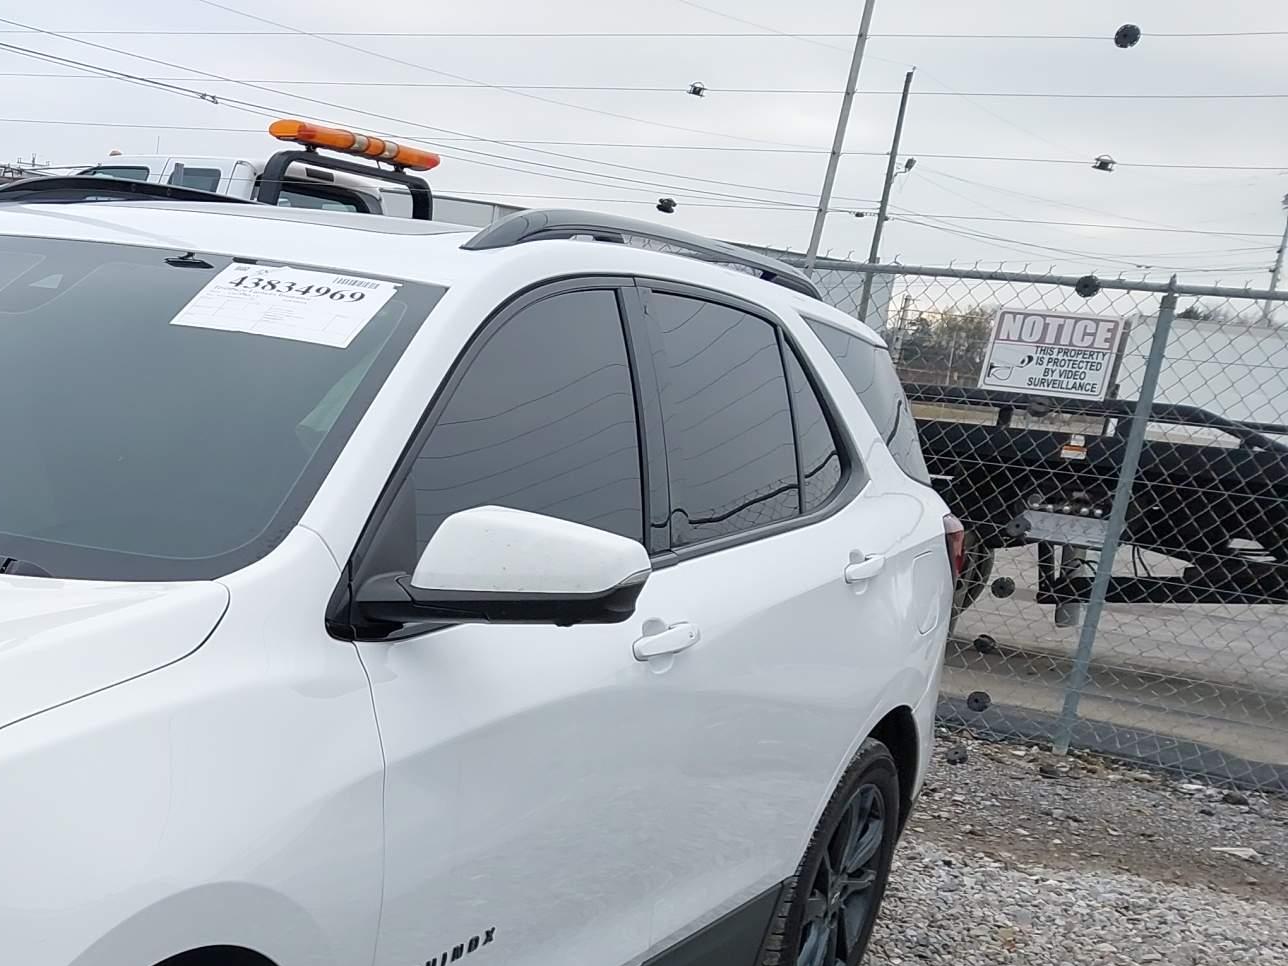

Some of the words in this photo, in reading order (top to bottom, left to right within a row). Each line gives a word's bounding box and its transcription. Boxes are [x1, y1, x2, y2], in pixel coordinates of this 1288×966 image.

[228, 275, 366, 303] 43834969
[999, 314, 1115, 348] NOTICE
[1035, 346, 1055, 356] THIS
[1056, 347, 1107, 361] PROPERTY
[1035, 356, 1045, 366] IS
[1046, 357, 1103, 371] PROTECTED
[1042, 367, 1057, 378] BY
[1058, 369, 1087, 381] VIDEO
[1026, 377, 1098, 393] SURVEILLANCE
